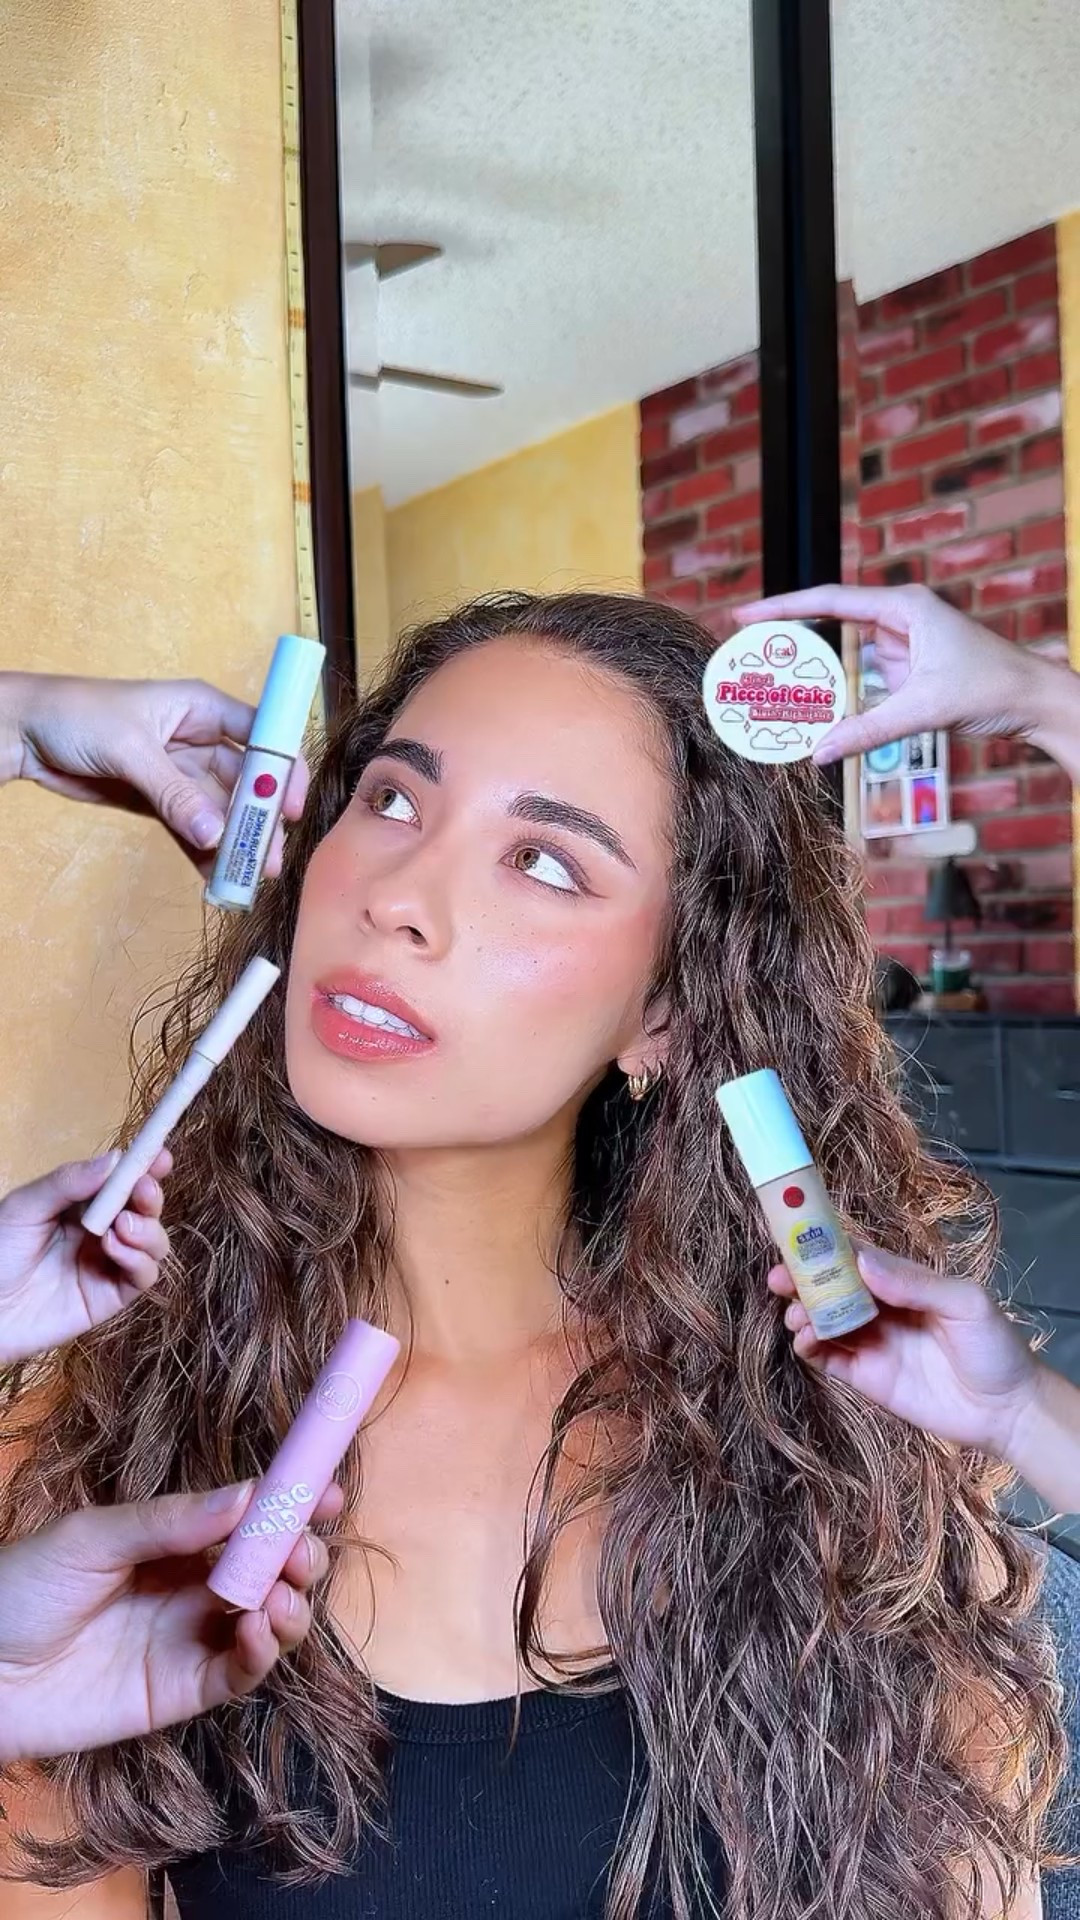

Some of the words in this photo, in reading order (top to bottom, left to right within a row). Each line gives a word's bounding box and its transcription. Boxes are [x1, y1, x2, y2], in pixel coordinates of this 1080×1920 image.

[719, 684, 765, 701] Piece
[769, 687, 788, 701] of
[792, 688, 833, 705] Cake
